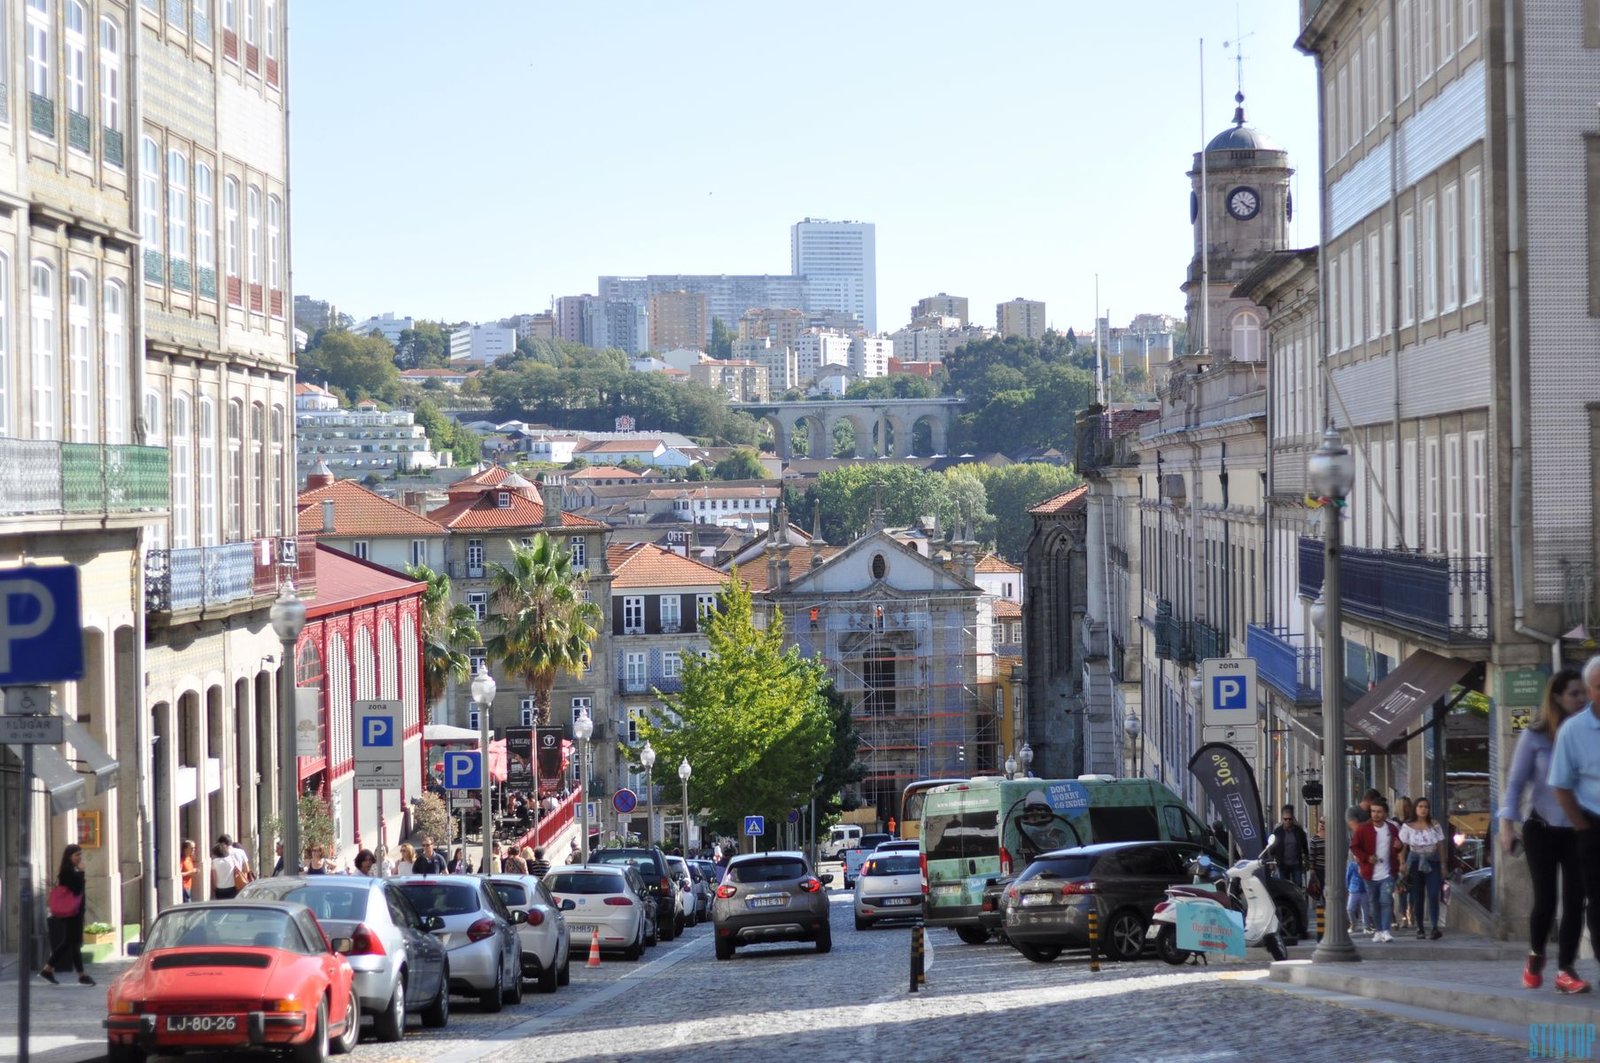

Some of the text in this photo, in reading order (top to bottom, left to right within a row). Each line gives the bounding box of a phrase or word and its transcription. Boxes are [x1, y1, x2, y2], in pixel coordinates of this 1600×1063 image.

[0, 579, 56, 674] P
[1220, 680, 1240, 707] P
[13, 720, 51, 730] LUGAR
[368, 719, 388, 744] P
[452, 755, 474, 786] P
[1050, 784, 1071, 794] DON'T
[1052, 791, 1080, 802] WORRY
[167, 1017, 236, 1031] LJ-80-26
